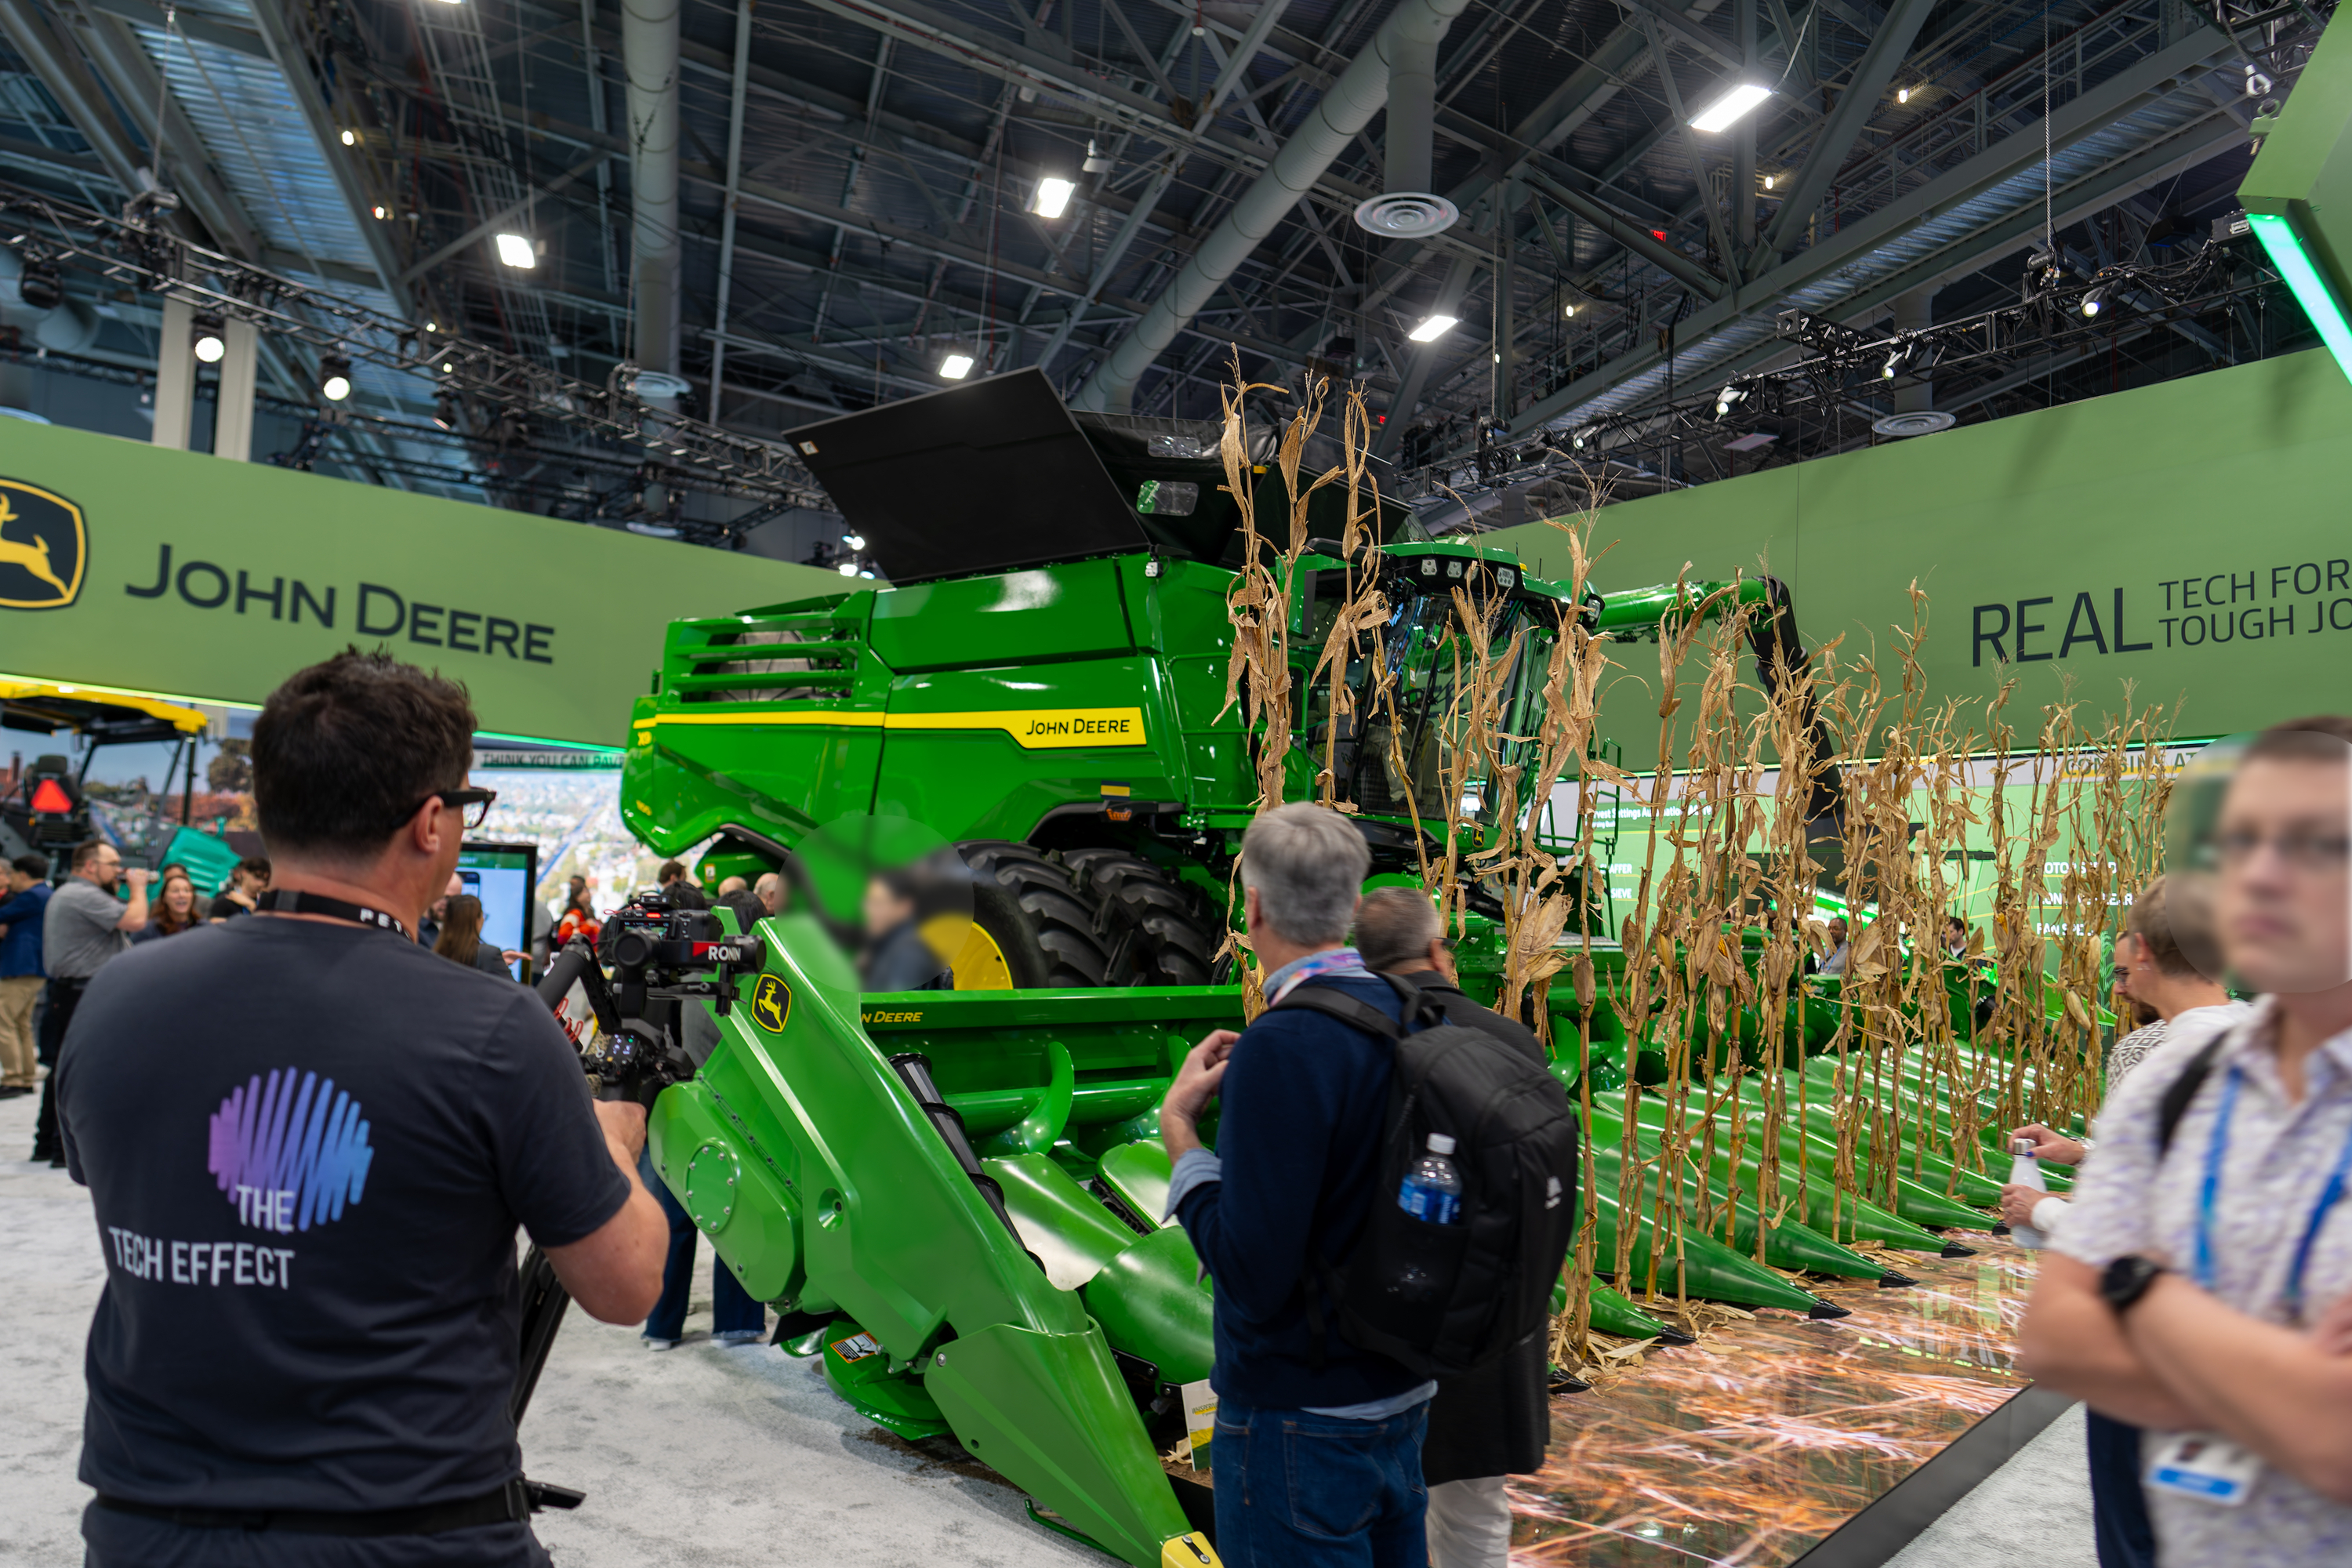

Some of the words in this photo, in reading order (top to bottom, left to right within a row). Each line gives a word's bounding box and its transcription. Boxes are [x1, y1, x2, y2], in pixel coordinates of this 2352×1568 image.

[2158, 571, 2255, 611] TECH
[2272, 559, 2350, 598] FOR
[125, 543, 336, 629] JOHN
[356, 582, 554, 665] DEERE
[1973, 587, 2153, 667] REAL
[2158, 604, 2294, 648] TOUGH
[1026, 720, 1069, 735] JOHN
[1073, 718, 1130, 734] DEERE
[483, 753, 524, 765] THINK
[529, 754, 557, 766] YOU
[561, 755, 590, 767] CAN
[2065, 753, 2163, 775] COBIN
[1584, 808, 1611, 818] rvest
[1612, 807, 1641, 820] Sttings
[2044, 861, 2078, 875] OTO
[1610, 887, 1632, 898] SIEVE
[708, 945, 741, 961] RONIN
[873, 1011, 924, 1023] DEERE
[236, 1185, 295, 1232] THE
[108, 1225, 164, 1282] TECH
[171, 1240, 296, 1290] EFFECT
